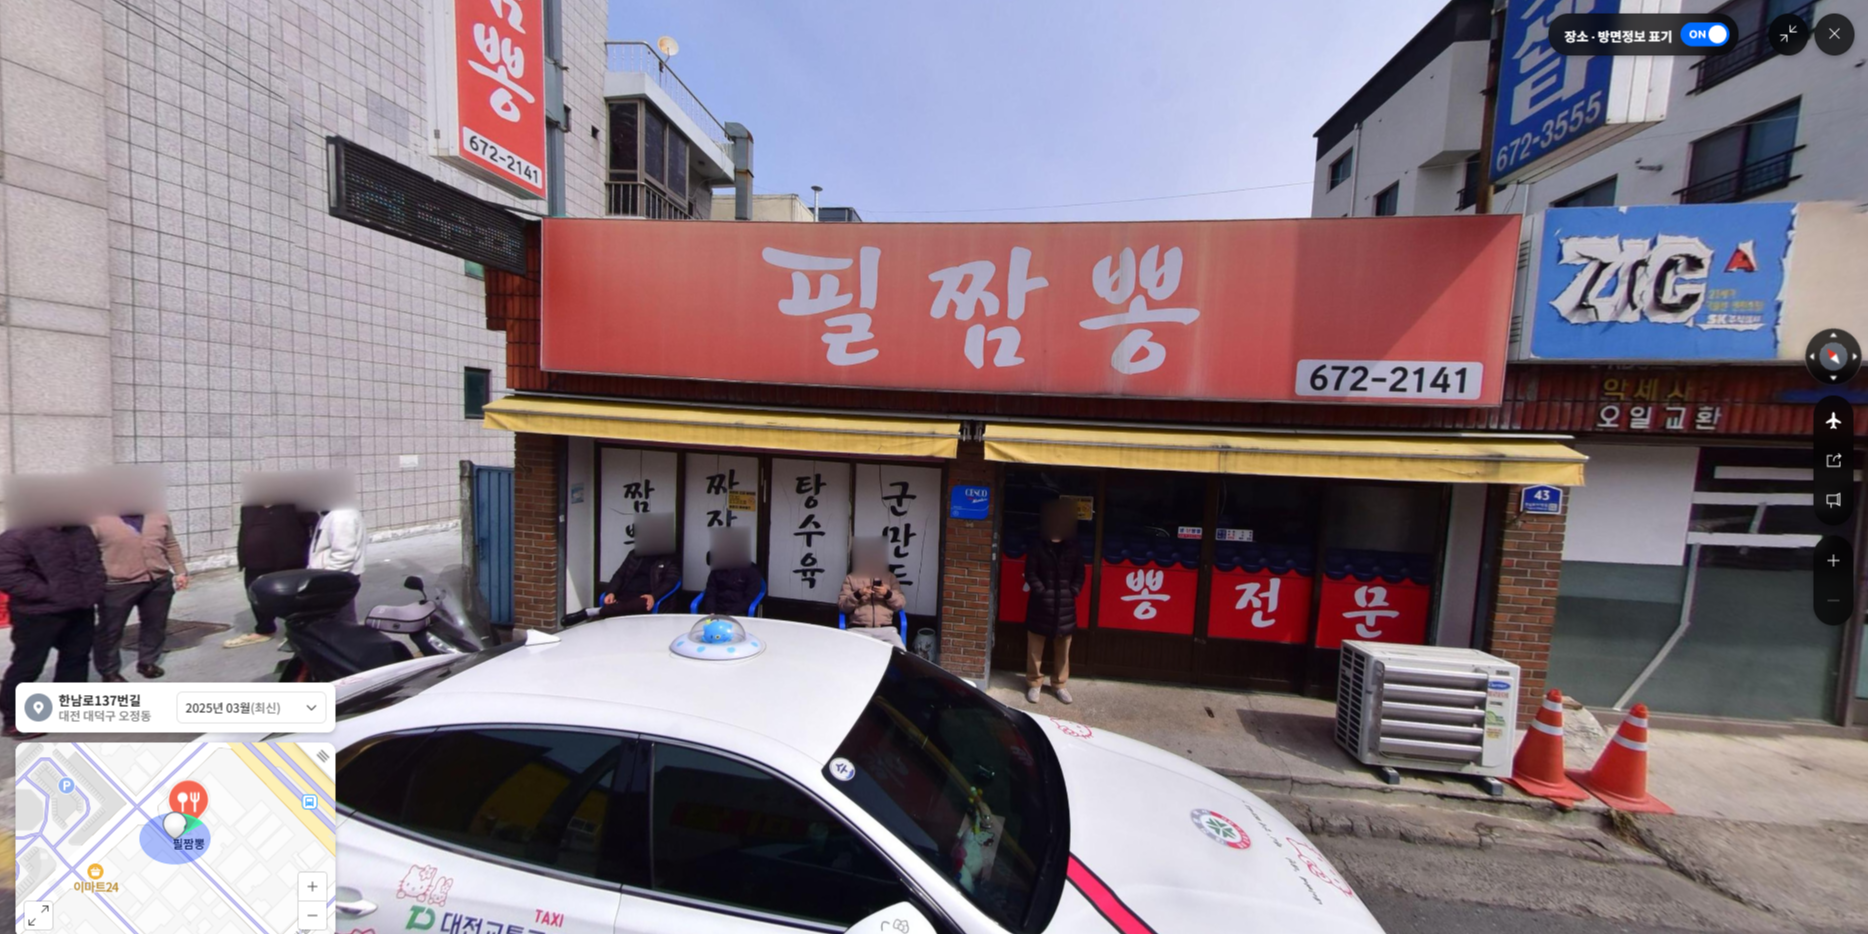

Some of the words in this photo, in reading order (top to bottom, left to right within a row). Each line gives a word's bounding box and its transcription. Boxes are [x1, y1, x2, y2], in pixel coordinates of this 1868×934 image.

[469, 135, 539, 184] 672-2141
[1495, 90, 1603, 172] 672-3555
[761, 244, 1201, 375] 필짬뽕
[1550, 234, 1715, 325] ZIC
[1309, 364, 1468, 394] 672-2141
[1533, 489, 1551, 501] 43
[793, 473, 827, 589] 탕수육
[535, 909, 565, 928] TAXI
